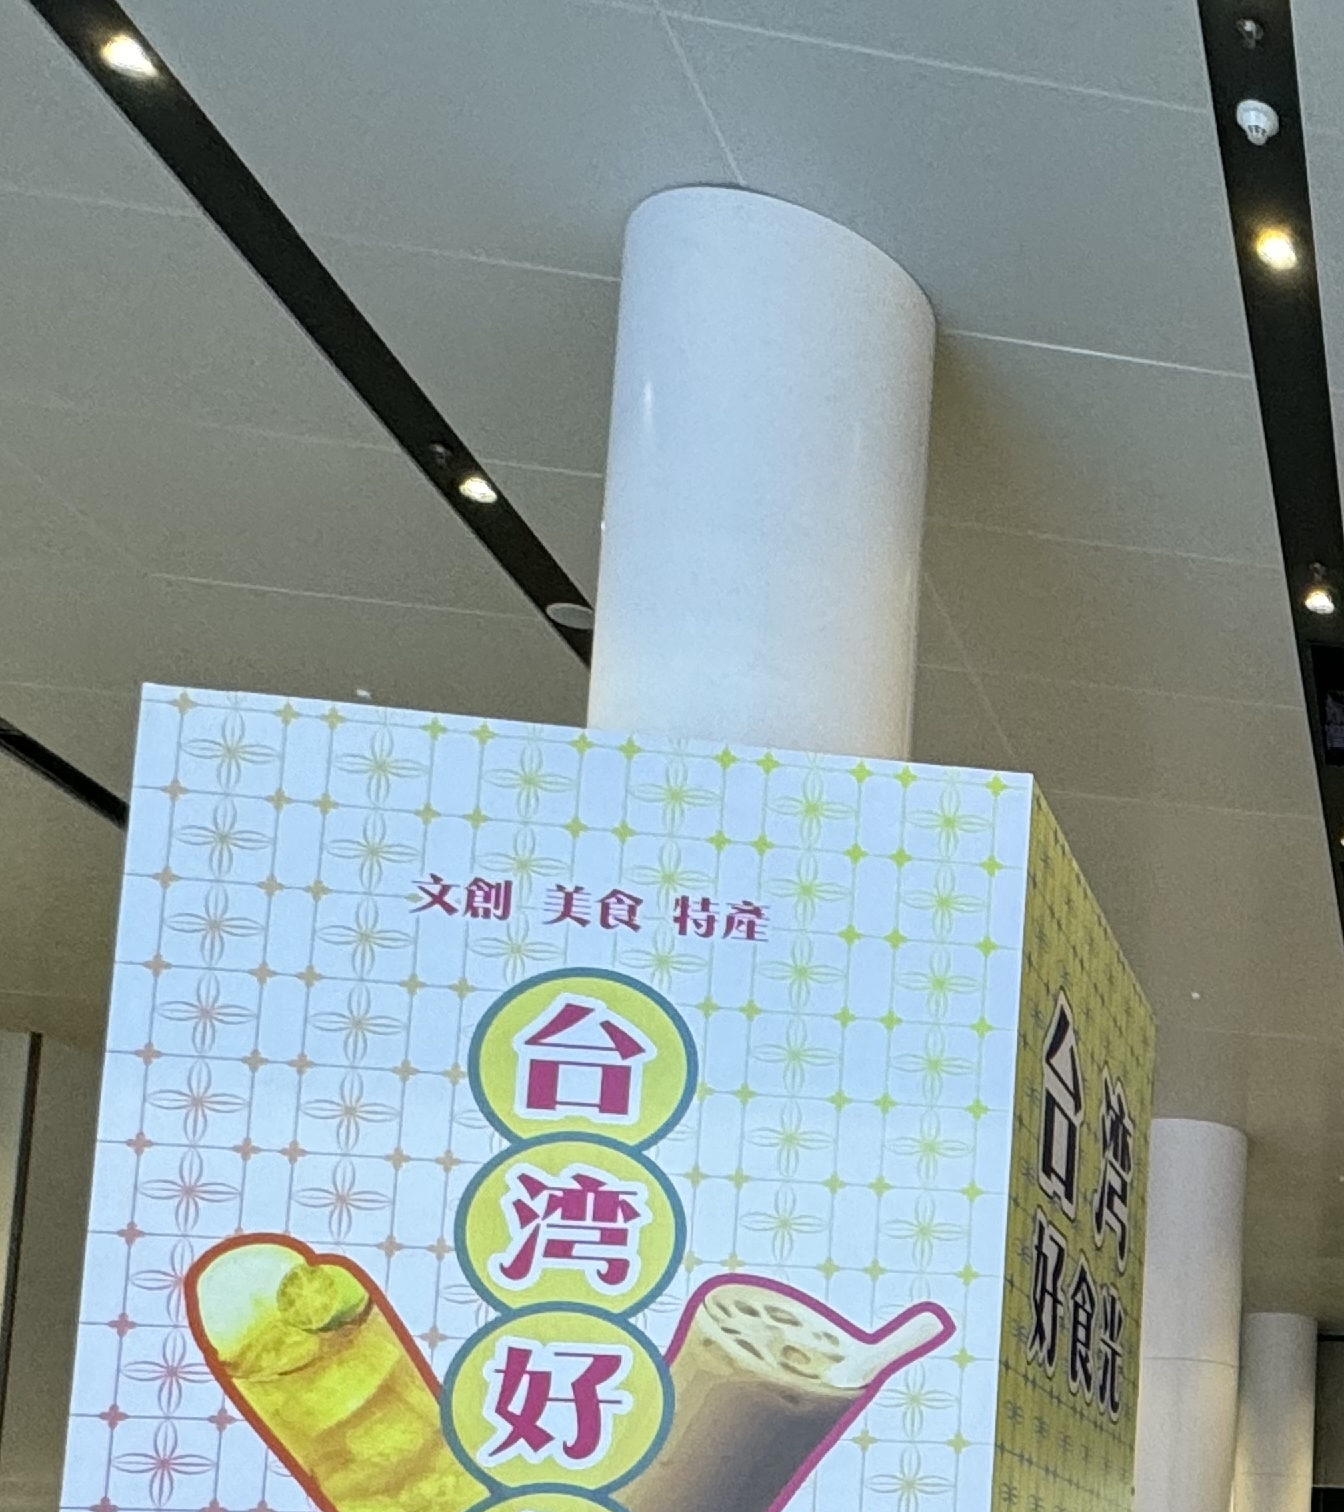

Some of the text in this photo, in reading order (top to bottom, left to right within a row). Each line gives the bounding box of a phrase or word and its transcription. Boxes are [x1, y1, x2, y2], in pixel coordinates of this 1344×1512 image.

[409, 873, 514, 921] 文創
[543, 884, 645, 933] 美食
[1040, 997, 1132, 1272] 台湾
[1029, 1210, 1124, 1420] 好食光
